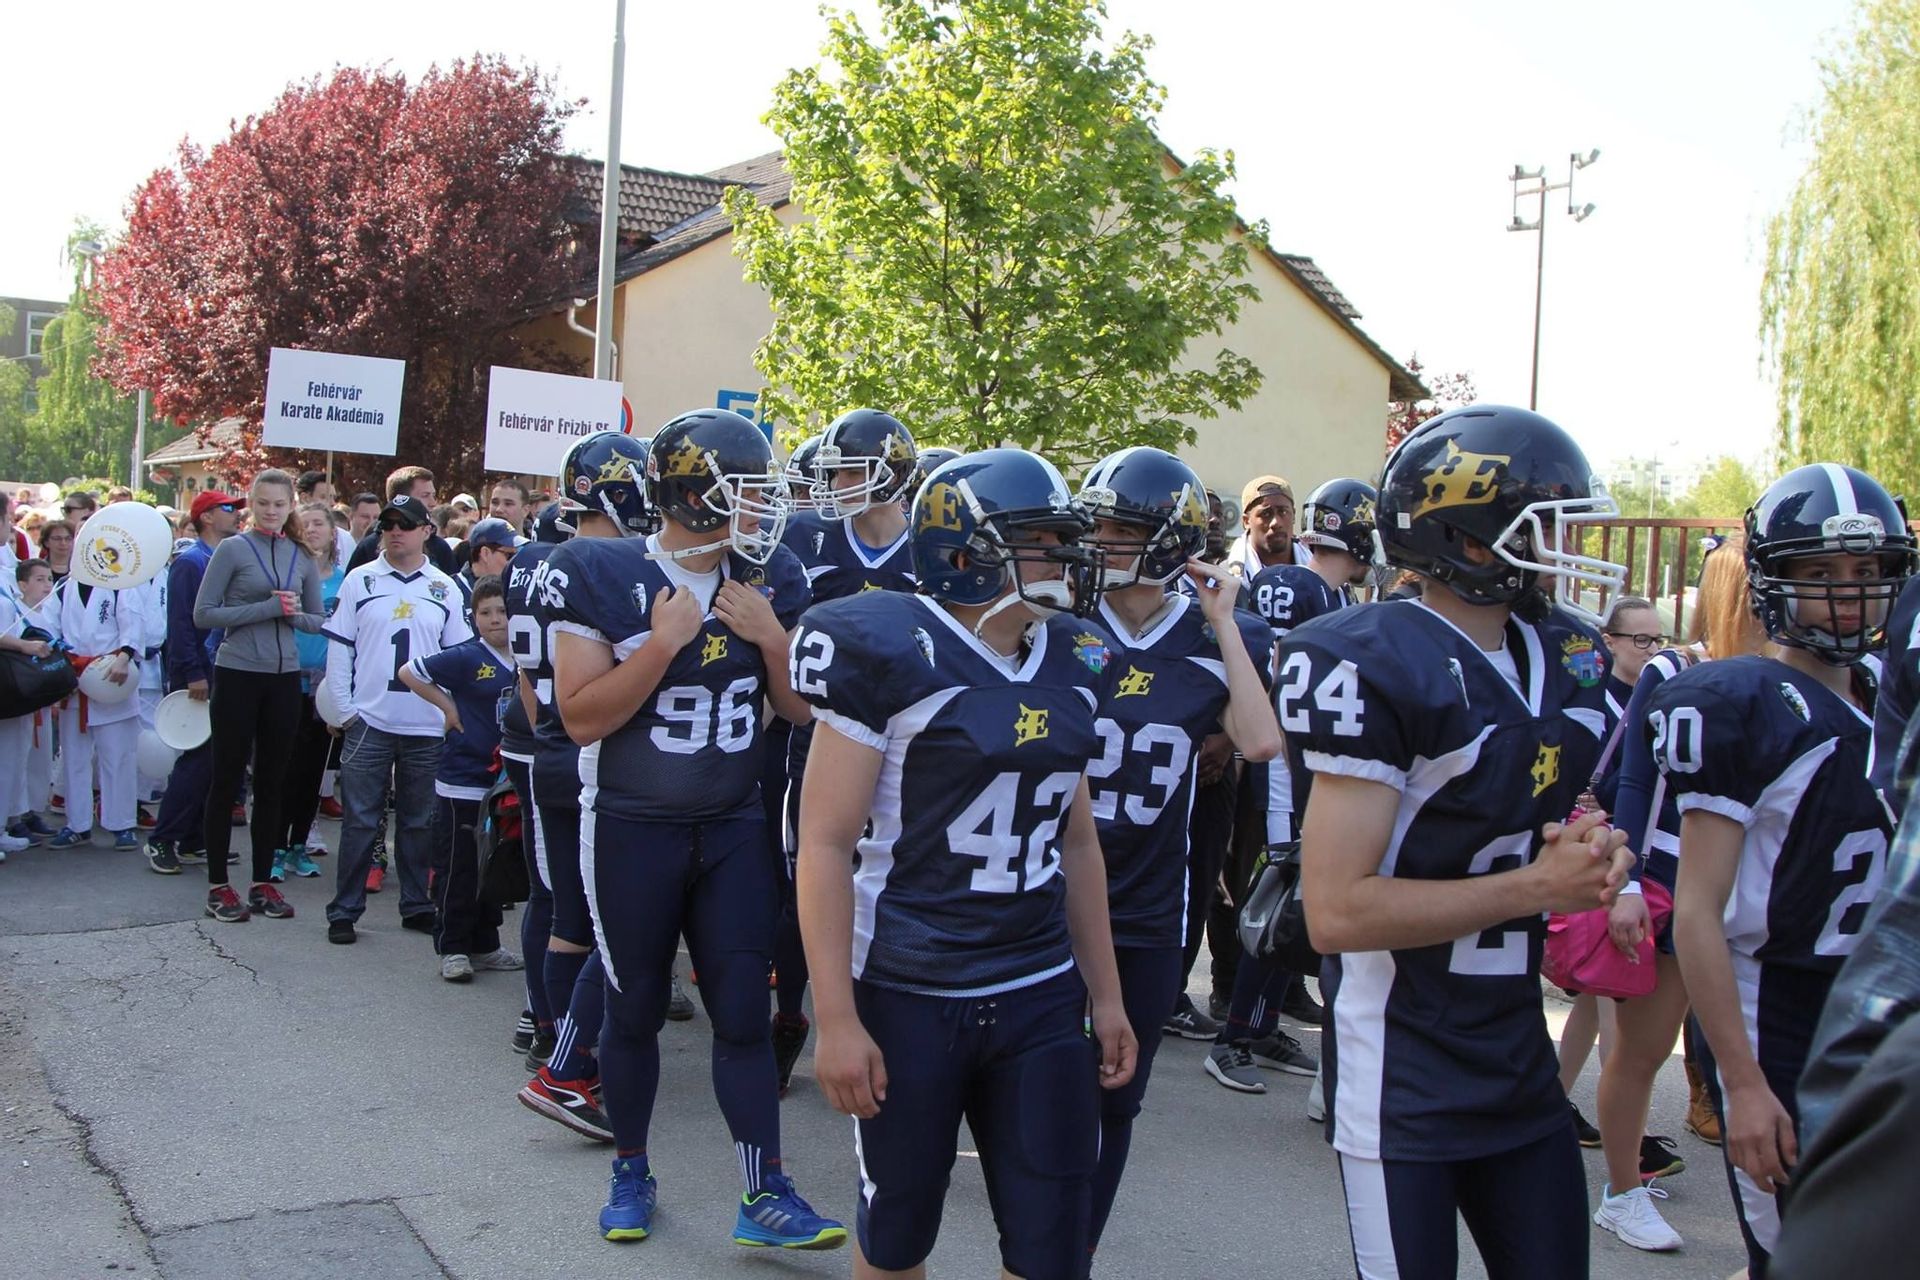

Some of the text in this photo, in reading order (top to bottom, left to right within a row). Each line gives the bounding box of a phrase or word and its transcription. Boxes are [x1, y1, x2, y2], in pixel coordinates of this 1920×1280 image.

[281, 401, 384, 425] Karate Akadémia
[308, 381, 363, 401] Fehérvár
[499, 411, 554, 433] Fehérvár
[558, 418, 592, 437] Frizbi
[1257, 584, 1295, 620] 82
[387, 628, 412, 693] 1
[1279, 651, 1365, 737] 24
[650, 676, 759, 755] 96
[1648, 706, 1703, 775] 20
[1085, 717, 1192, 826] 23
[946, 771, 1081, 893] 42
